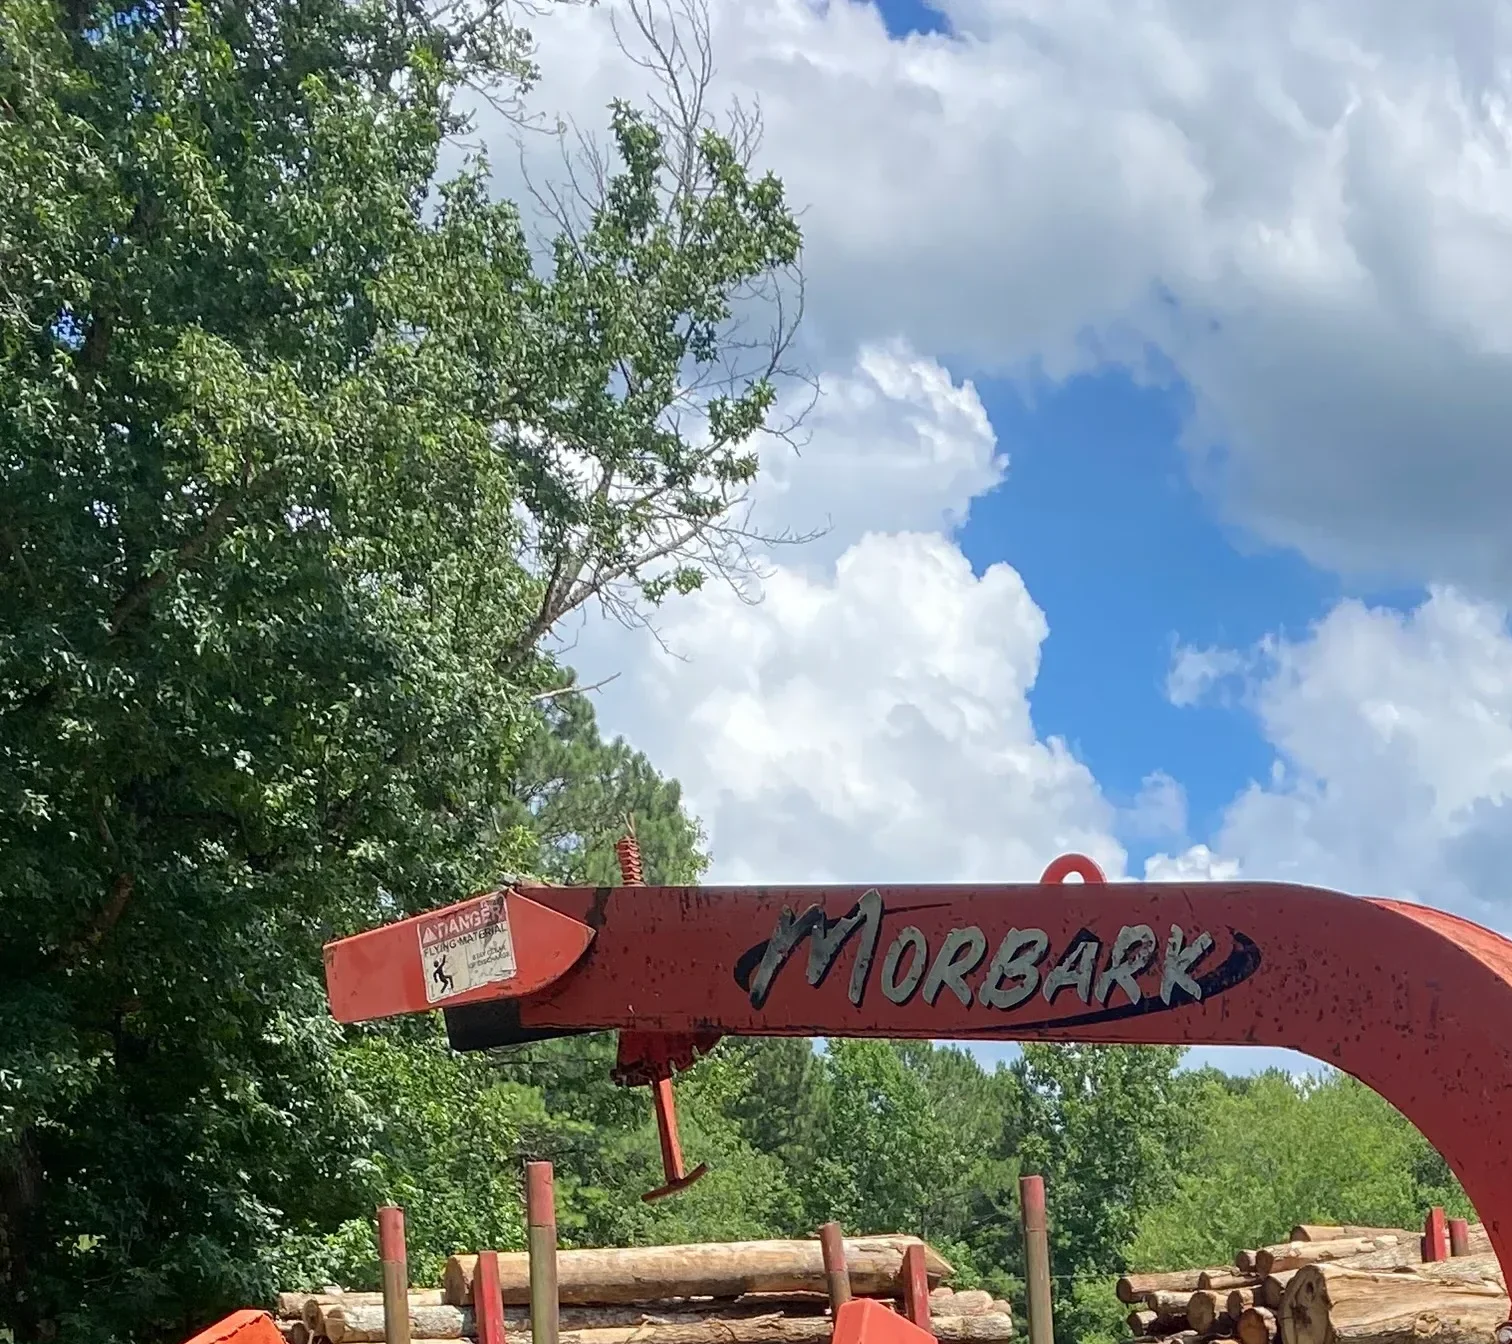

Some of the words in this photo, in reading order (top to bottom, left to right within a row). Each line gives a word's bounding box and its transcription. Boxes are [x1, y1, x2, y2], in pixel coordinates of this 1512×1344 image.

[434, 904, 505, 938] DANGER
[424, 940, 457, 957] FLYING
[459, 924, 507, 945] MATERIAL
[749, 888, 1214, 1010] MORBARK
